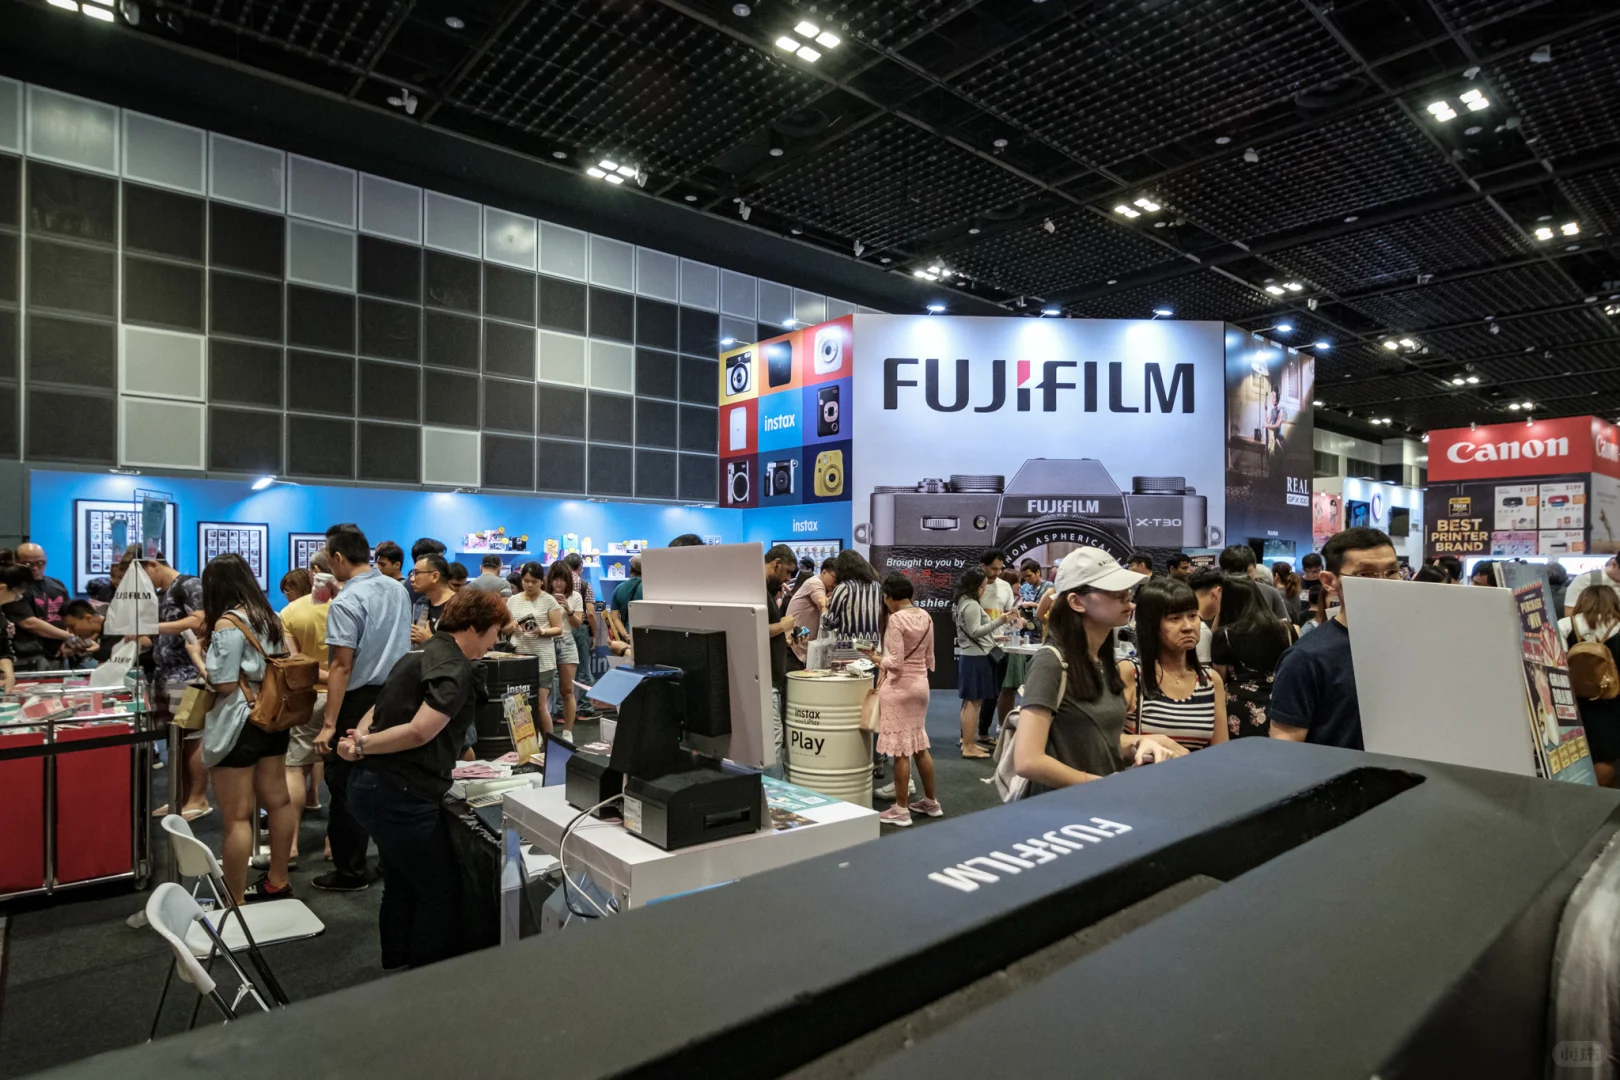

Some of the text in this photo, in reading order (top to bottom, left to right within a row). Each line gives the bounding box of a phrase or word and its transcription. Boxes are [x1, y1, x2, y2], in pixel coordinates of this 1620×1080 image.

[883, 357, 1195, 414] FUJIFILM
[764, 413, 796, 432] instax
[1446, 437, 1569, 464] Canon
[1286, 476, 1310, 495] REAL
[1027, 499, 1099, 514] FUJIFILM
[792, 518, 818, 532] instax
[1136, 518, 1182, 527] X-T30
[1437, 518, 1483, 532] BEST
[1431, 531, 1489, 542] PRINTER
[1435, 541, 1484, 552] BRAND
[886, 557, 966, 569] Brought to you by
[914, 597, 950, 608] ashier
[794, 706, 820, 720] instax
[791, 730, 826, 756] Play
[927, 816, 1133, 893] FUJIFILM
